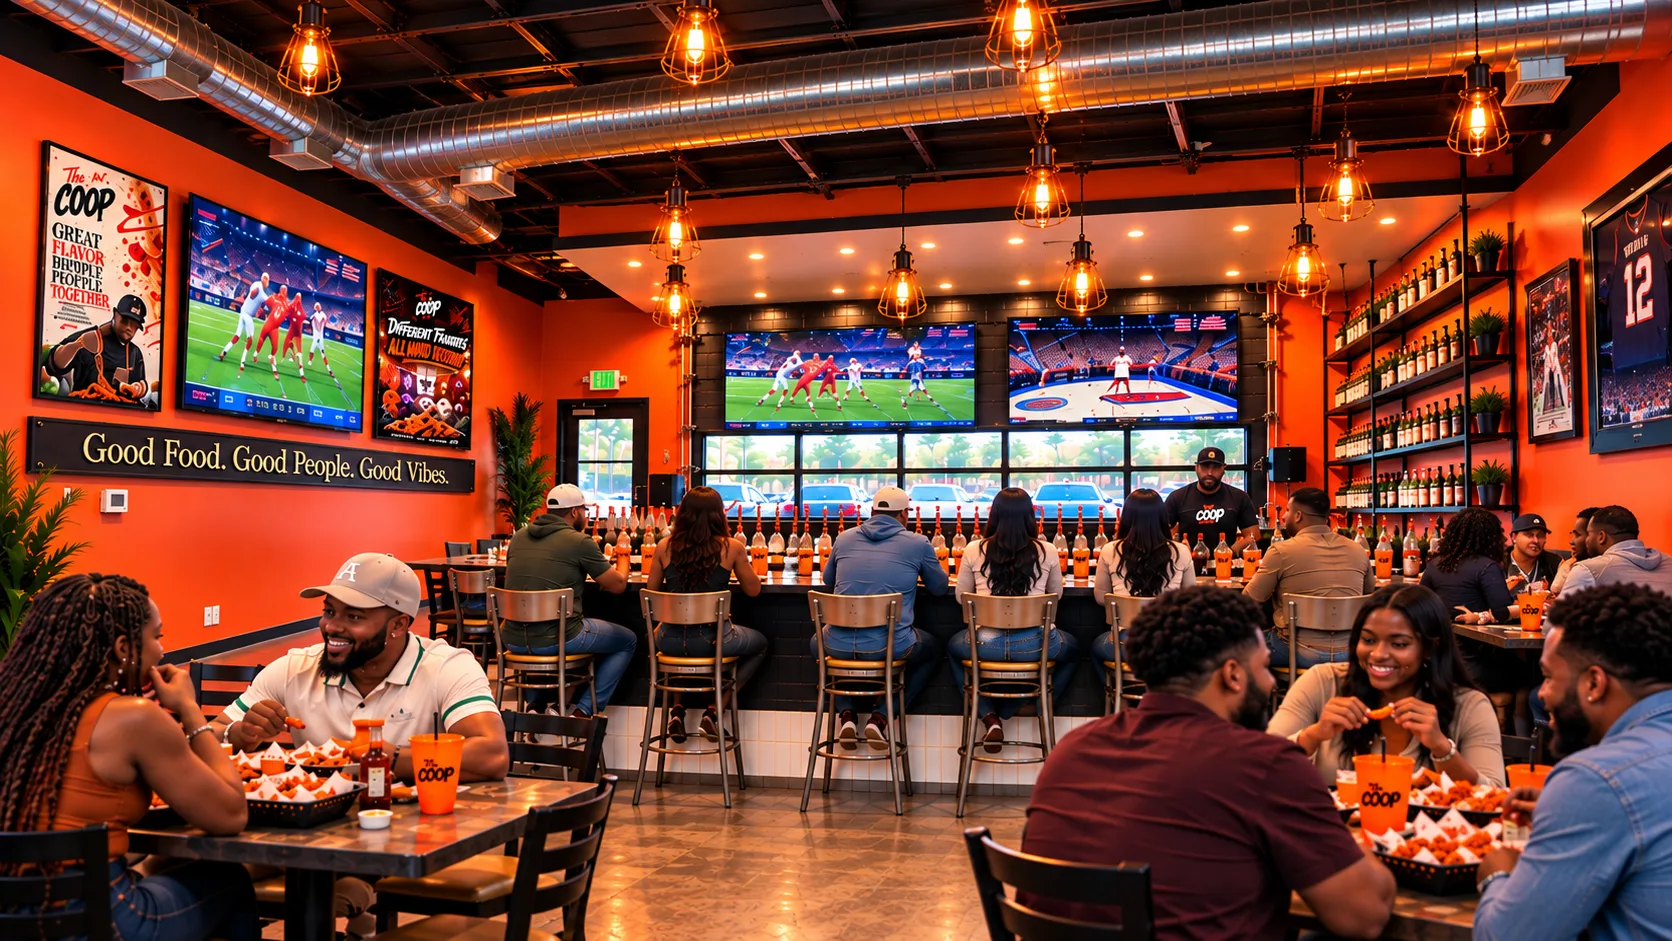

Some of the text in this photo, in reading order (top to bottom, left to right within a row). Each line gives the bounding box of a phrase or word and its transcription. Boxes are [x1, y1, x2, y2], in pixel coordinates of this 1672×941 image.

[62, 166, 85, 184] The
[54, 183, 116, 222] COOP
[52, 222, 103, 250] GREAT
[52, 239, 105, 267] FLAVOR
[50, 284, 110, 309] TOGETHER
[1623, 252, 1654, 328] 12
[82, 432, 449, 485] Good Food. Good People. Good Vibes.
[1196, 508, 1225, 523] COOP
[336, 562, 360, 583] A
[418, 766, 455, 783] COOP
[1361, 791, 1401, 808] COOP
